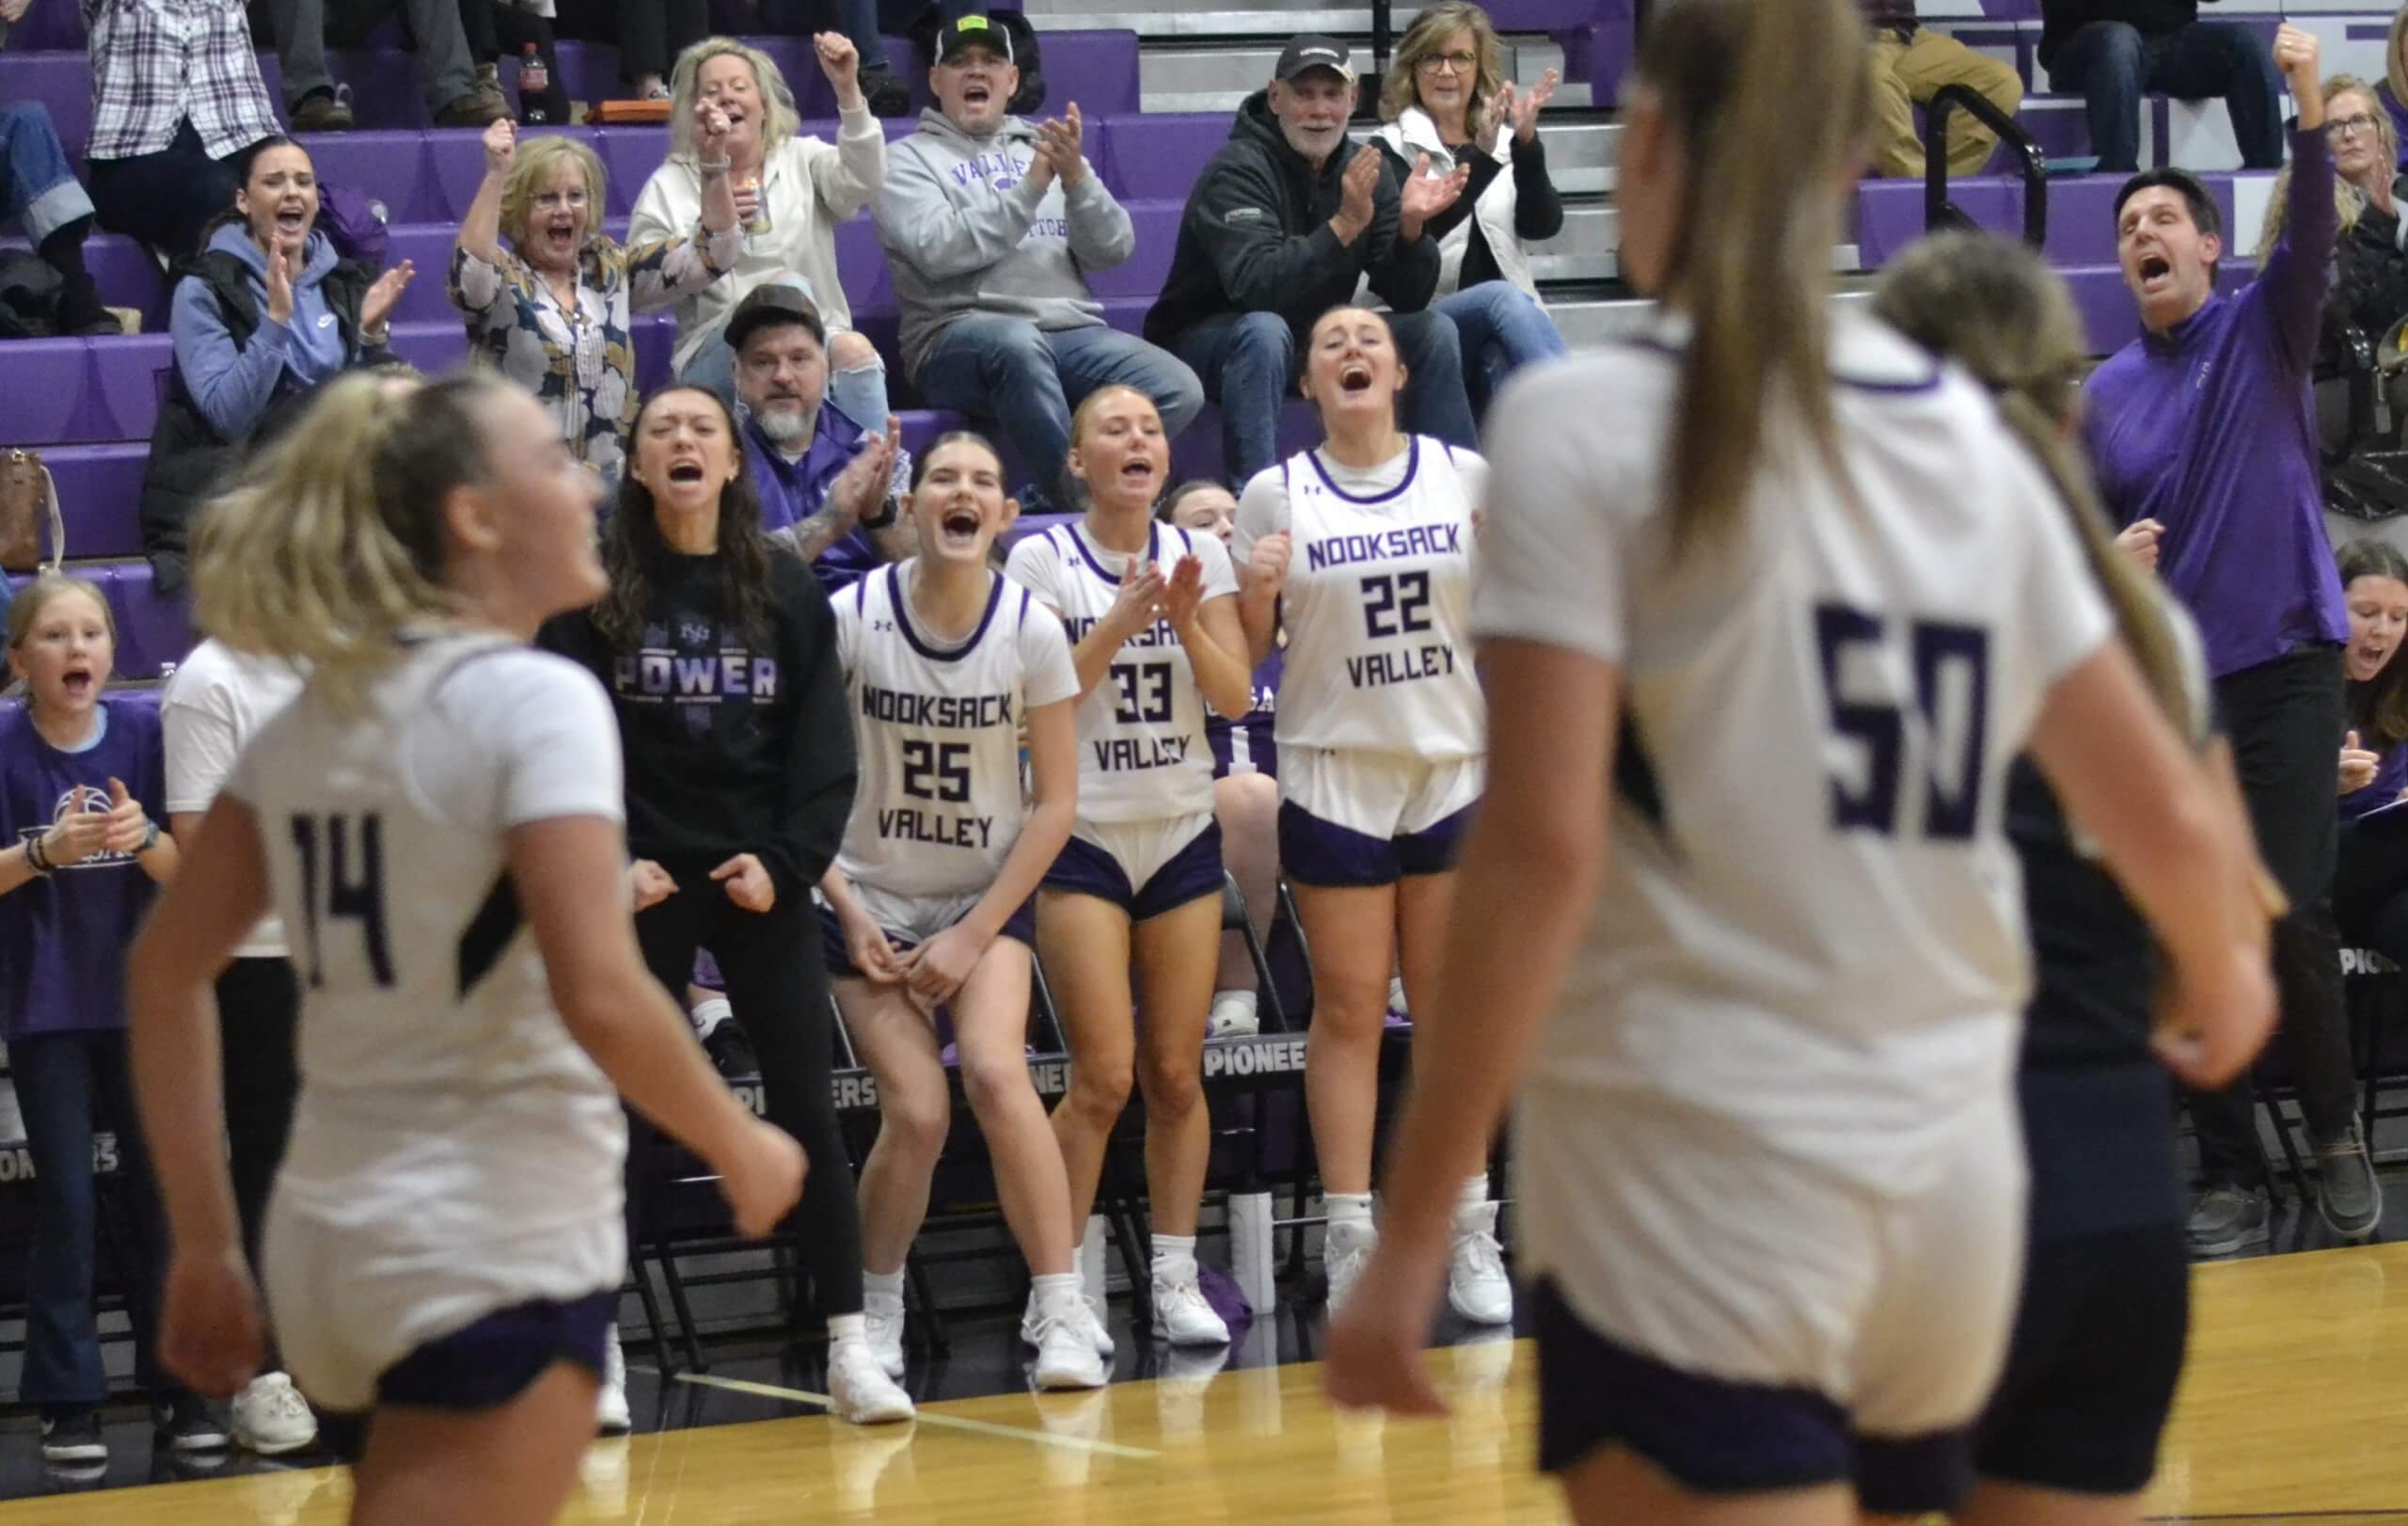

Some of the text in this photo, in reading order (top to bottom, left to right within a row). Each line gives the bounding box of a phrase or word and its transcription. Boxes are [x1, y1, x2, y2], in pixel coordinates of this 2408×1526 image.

[951, 152, 1032, 186] VALLE
[1307, 522, 1461, 572] NOOKSACK
[1360, 570, 1432, 639] 22
[614, 656, 777, 696] POWER
[1346, 644, 1453, 689] VALLEY
[863, 684, 1012, 728] NOOKSACK
[1109, 661, 1173, 724] 33
[1814, 601, 1988, 840] 50
[902, 739, 971, 803] 25
[1093, 734, 1192, 771] VALLEY
[879, 808, 993, 849] VALLEY
[292, 811, 397, 990] 14
[1203, 1041, 1307, 1077] PIONEE
